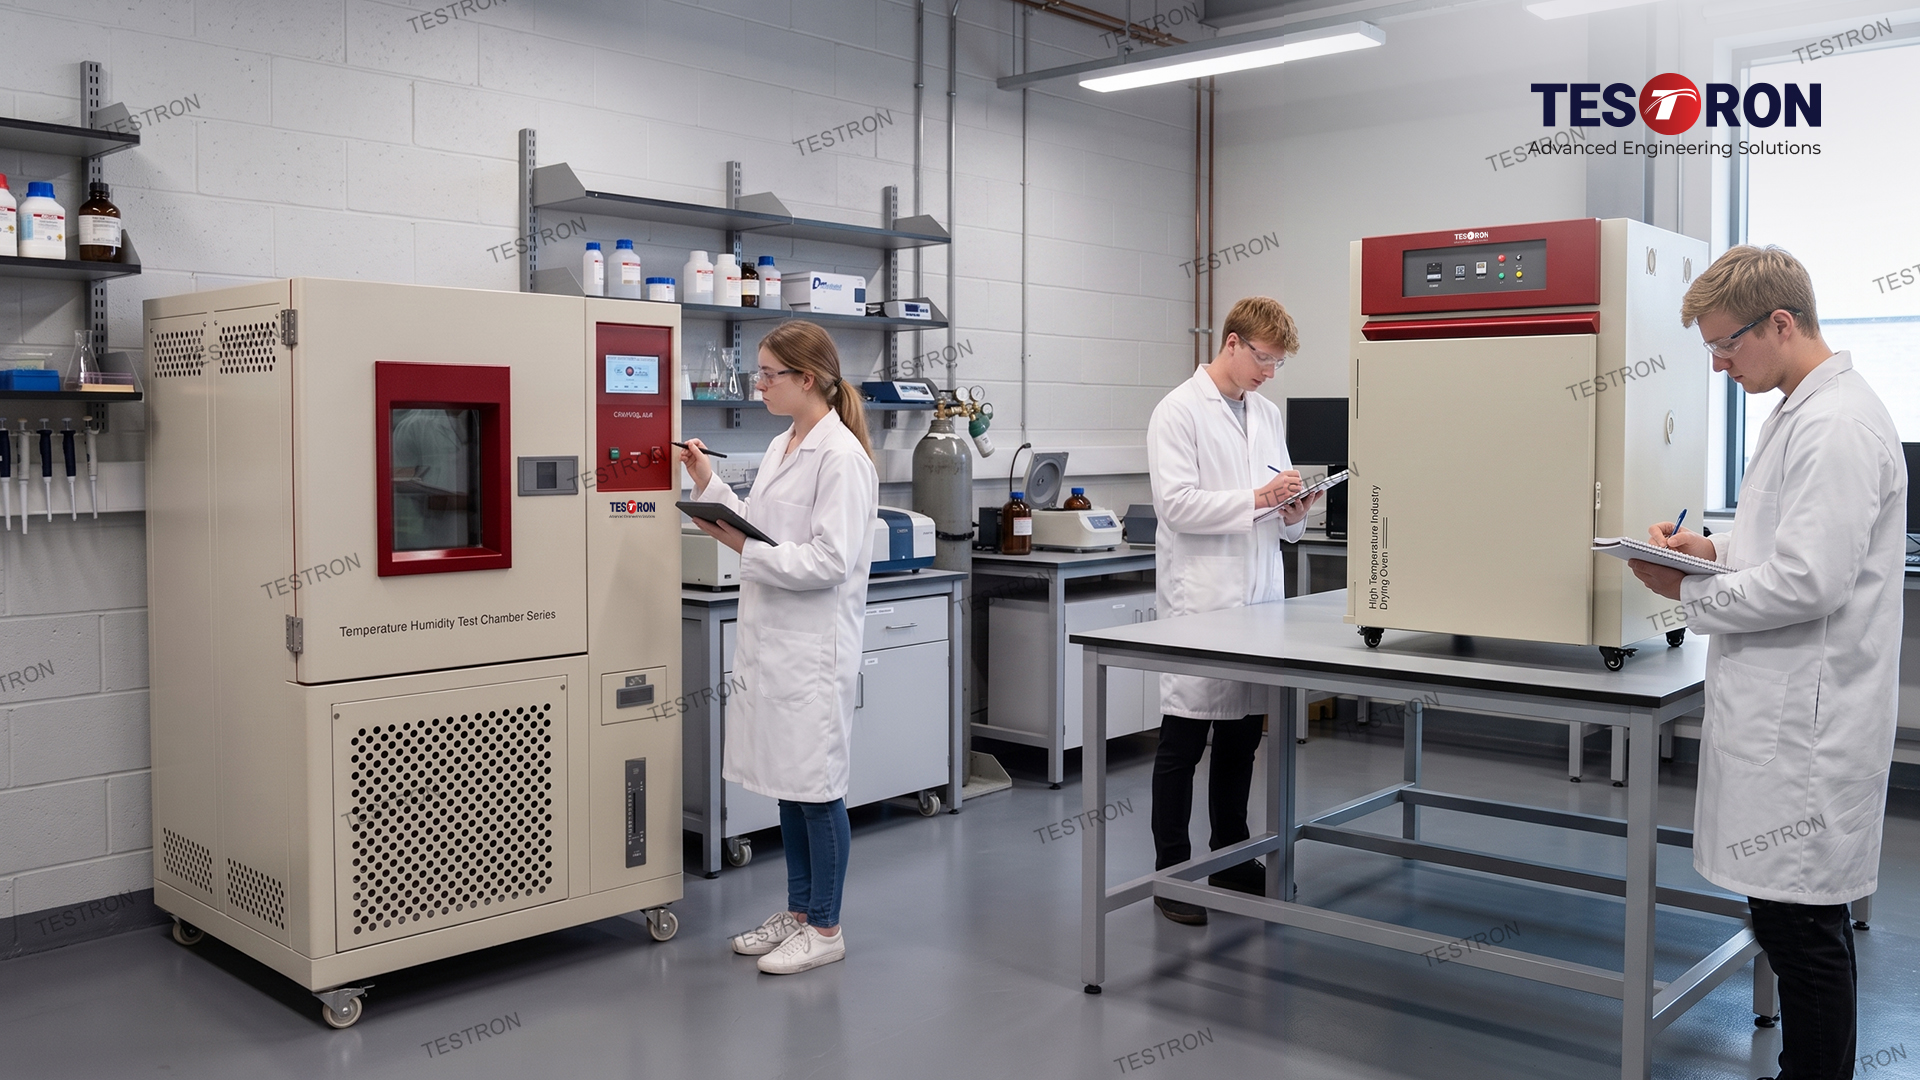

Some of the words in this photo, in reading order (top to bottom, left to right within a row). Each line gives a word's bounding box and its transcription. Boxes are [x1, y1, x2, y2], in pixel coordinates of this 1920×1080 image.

[609, 500, 656, 514] TESTRON
[1370, 485, 1381, 523] Industry
[1368, 525, 1379, 585] Temperature
[1379, 552, 1388, 577] Oven
[1369, 587, 1379, 610] High
[1379, 579, 1390, 610] Drying
[339, 623, 408, 638] Temperature
[410, 617, 455, 630] Humidity
[458, 616, 479, 627] Test
[480, 611, 524, 625] Chamber
[526, 609, 556, 621] Series
